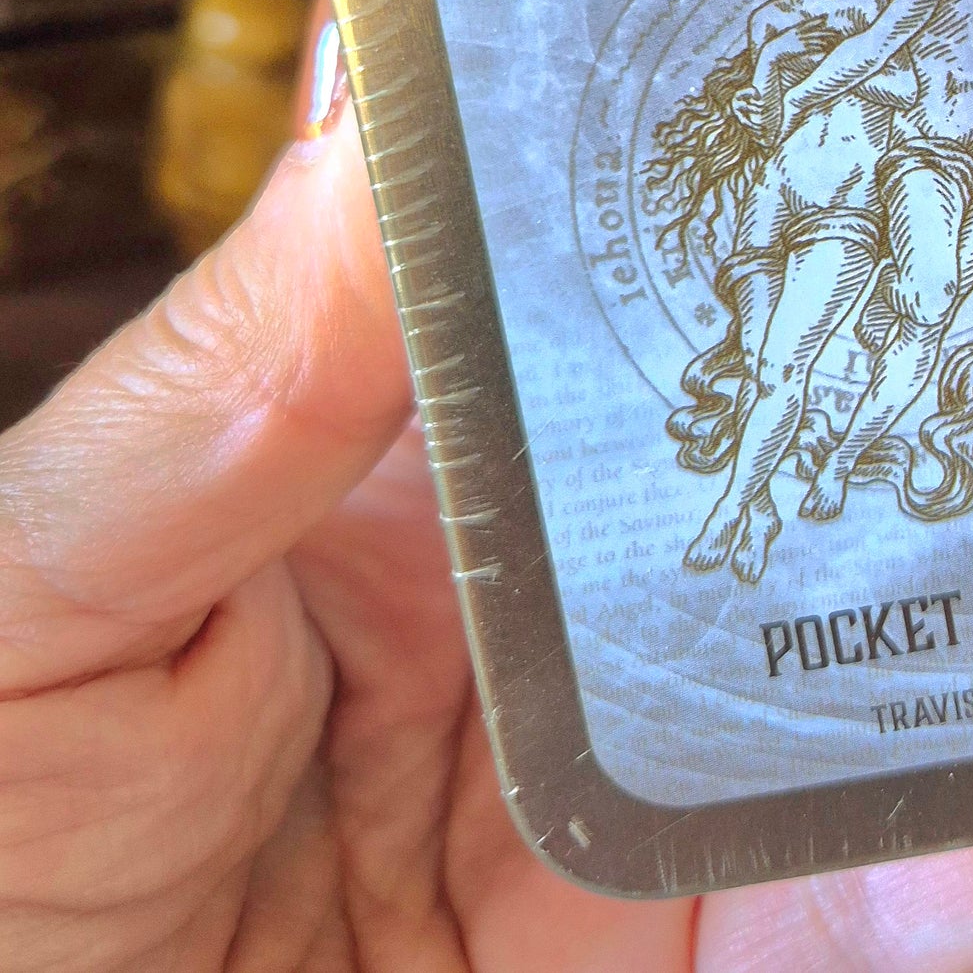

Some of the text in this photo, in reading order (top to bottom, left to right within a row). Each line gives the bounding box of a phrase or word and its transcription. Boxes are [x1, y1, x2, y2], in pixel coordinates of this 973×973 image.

[591, 458, 625, 483] the
[579, 517, 612, 541] the
[623, 537, 657, 561] the
[759, 590, 962, 678] POCKET
